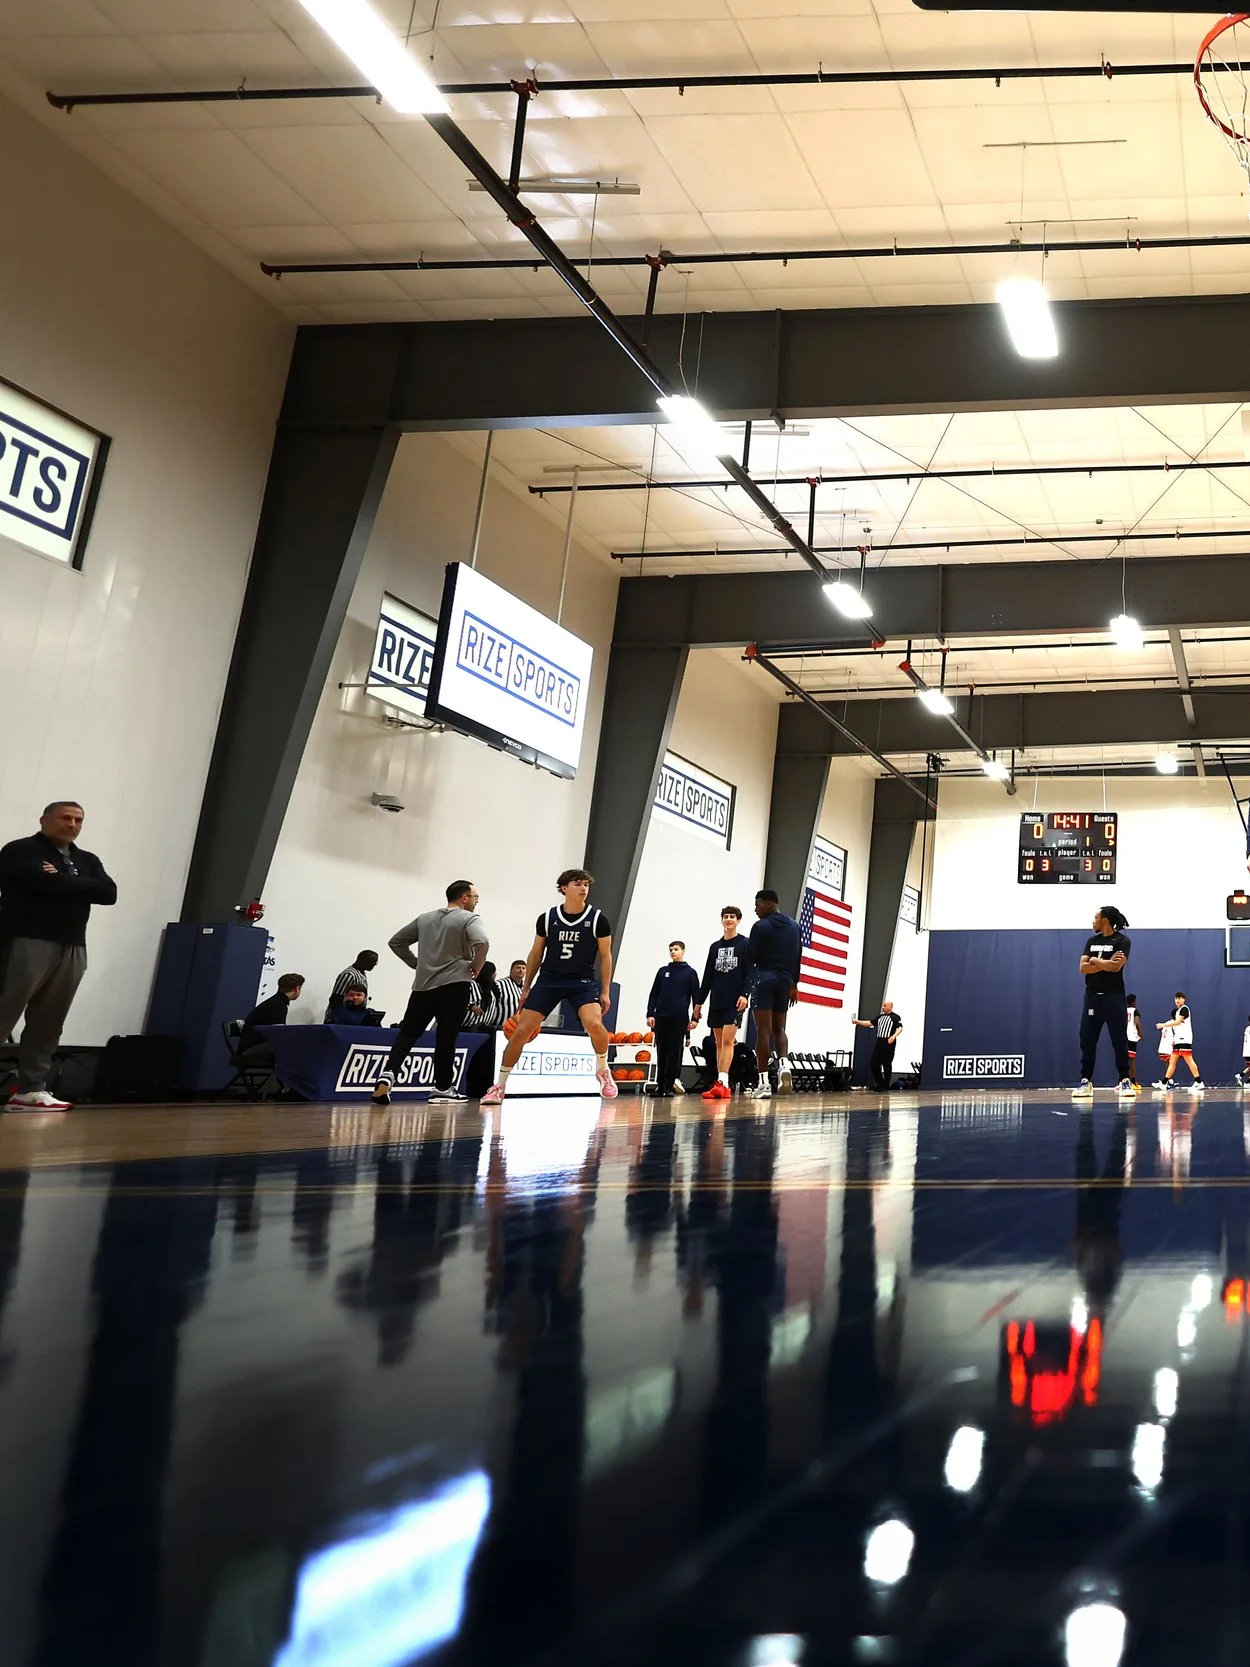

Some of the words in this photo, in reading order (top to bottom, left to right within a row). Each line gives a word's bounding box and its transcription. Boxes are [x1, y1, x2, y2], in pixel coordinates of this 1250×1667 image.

[378, 628, 434, 685] RIZE
[465, 625, 507, 679] RIZE
[513, 654, 575, 716] SPORTS
[685, 786, 726, 828] SPORTS
[1024, 814, 1041, 823] Home
[1093, 814, 1114, 823] Guests
[1033, 823, 1044, 839] 0
[1104, 823, 1115, 839] 0
[1058, 838, 1077, 847] period
[1021, 849, 1036, 857] fouls
[1057, 848, 1077, 858] player
[1098, 849, 1112, 857] fouls
[1025, 859, 1034, 872] 0
[1041, 859, 1050, 872] 3
[1084, 859, 1093, 872] 3
[1102, 859, 1111, 872] 0
[1058, 874, 1074, 882] game
[558, 930, 581, 942] RIZE
[560, 943, 575, 960] 5
[397, 1055, 460, 1084] SPOS
[516, 1056, 538, 1072] IZE
[545, 1056, 594, 1073] SPORTS
[947, 1059, 973, 1075] RIZE
[977, 1058, 1021, 1074] SPORTS
